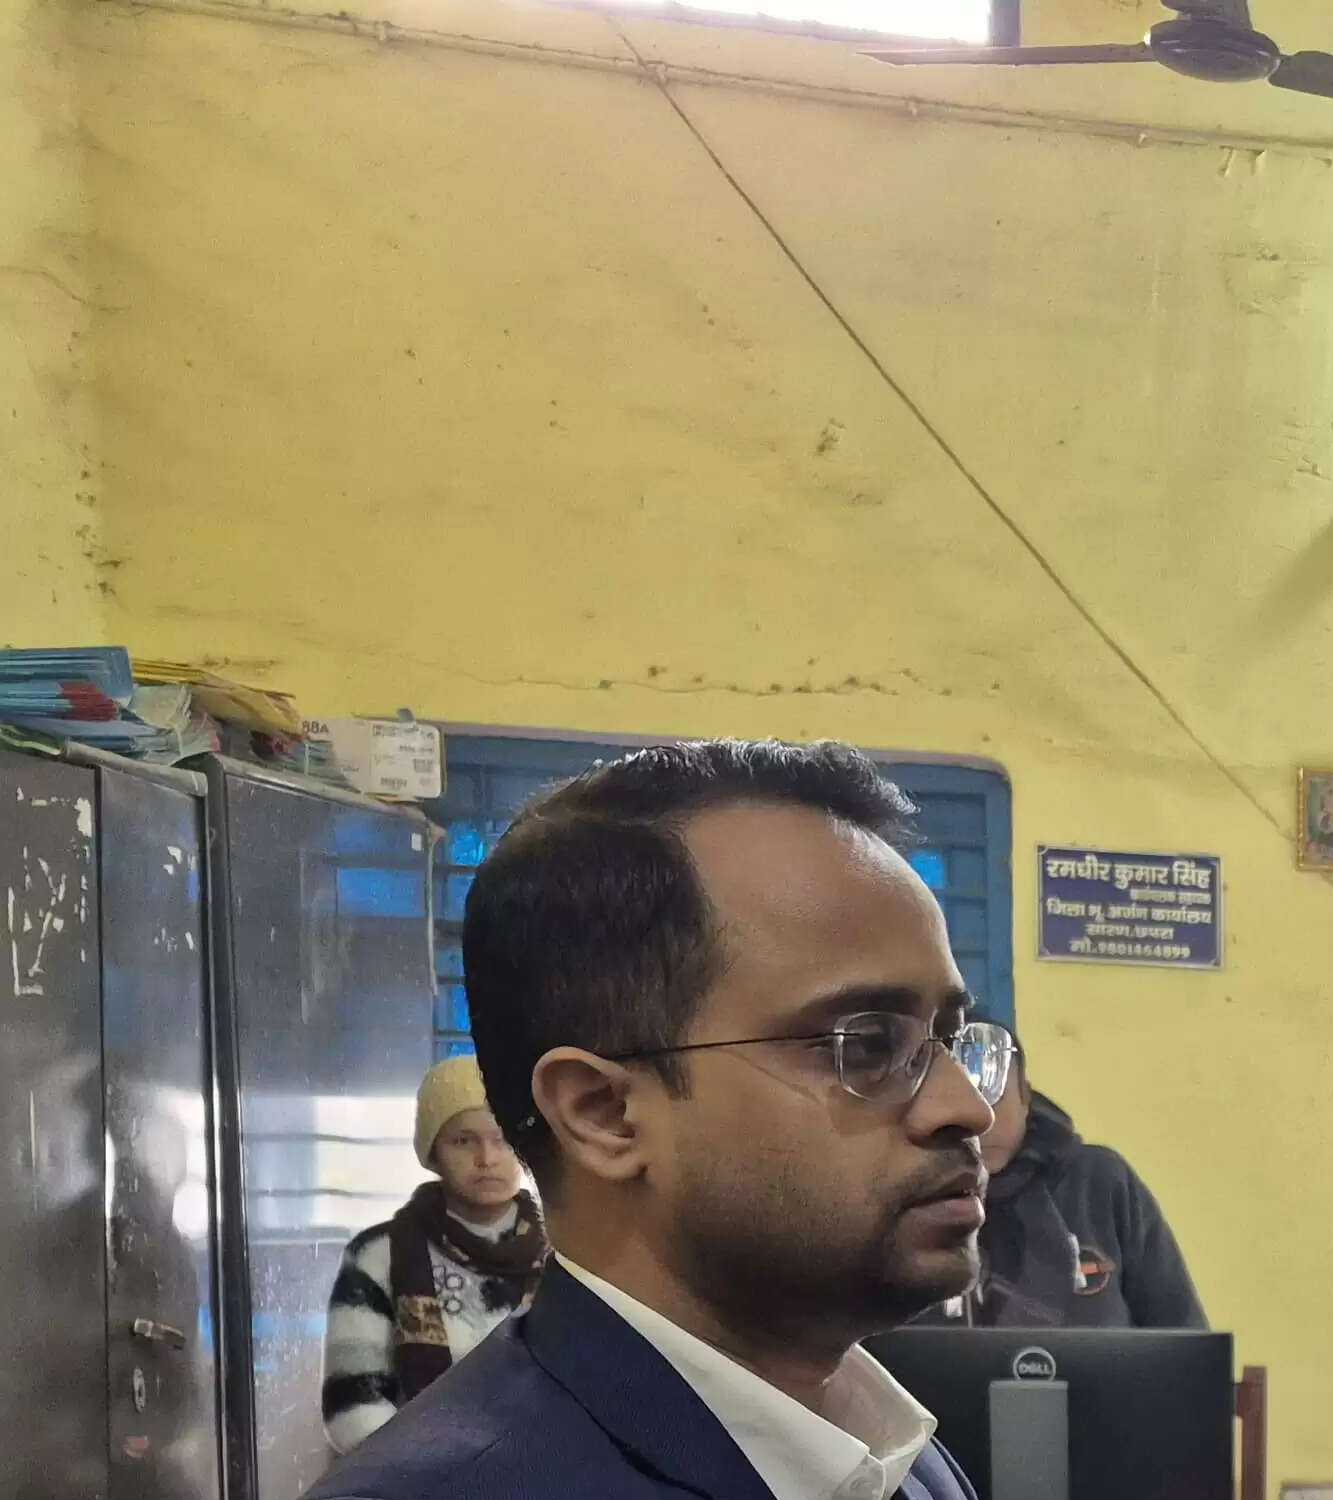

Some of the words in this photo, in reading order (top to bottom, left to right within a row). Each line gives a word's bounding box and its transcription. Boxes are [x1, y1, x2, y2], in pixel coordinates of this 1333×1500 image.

[1114, 864, 1168, 889] कुमार
[1173, 861, 1211, 888] सिंह
[1019, 1362, 1051, 1375] DELL
